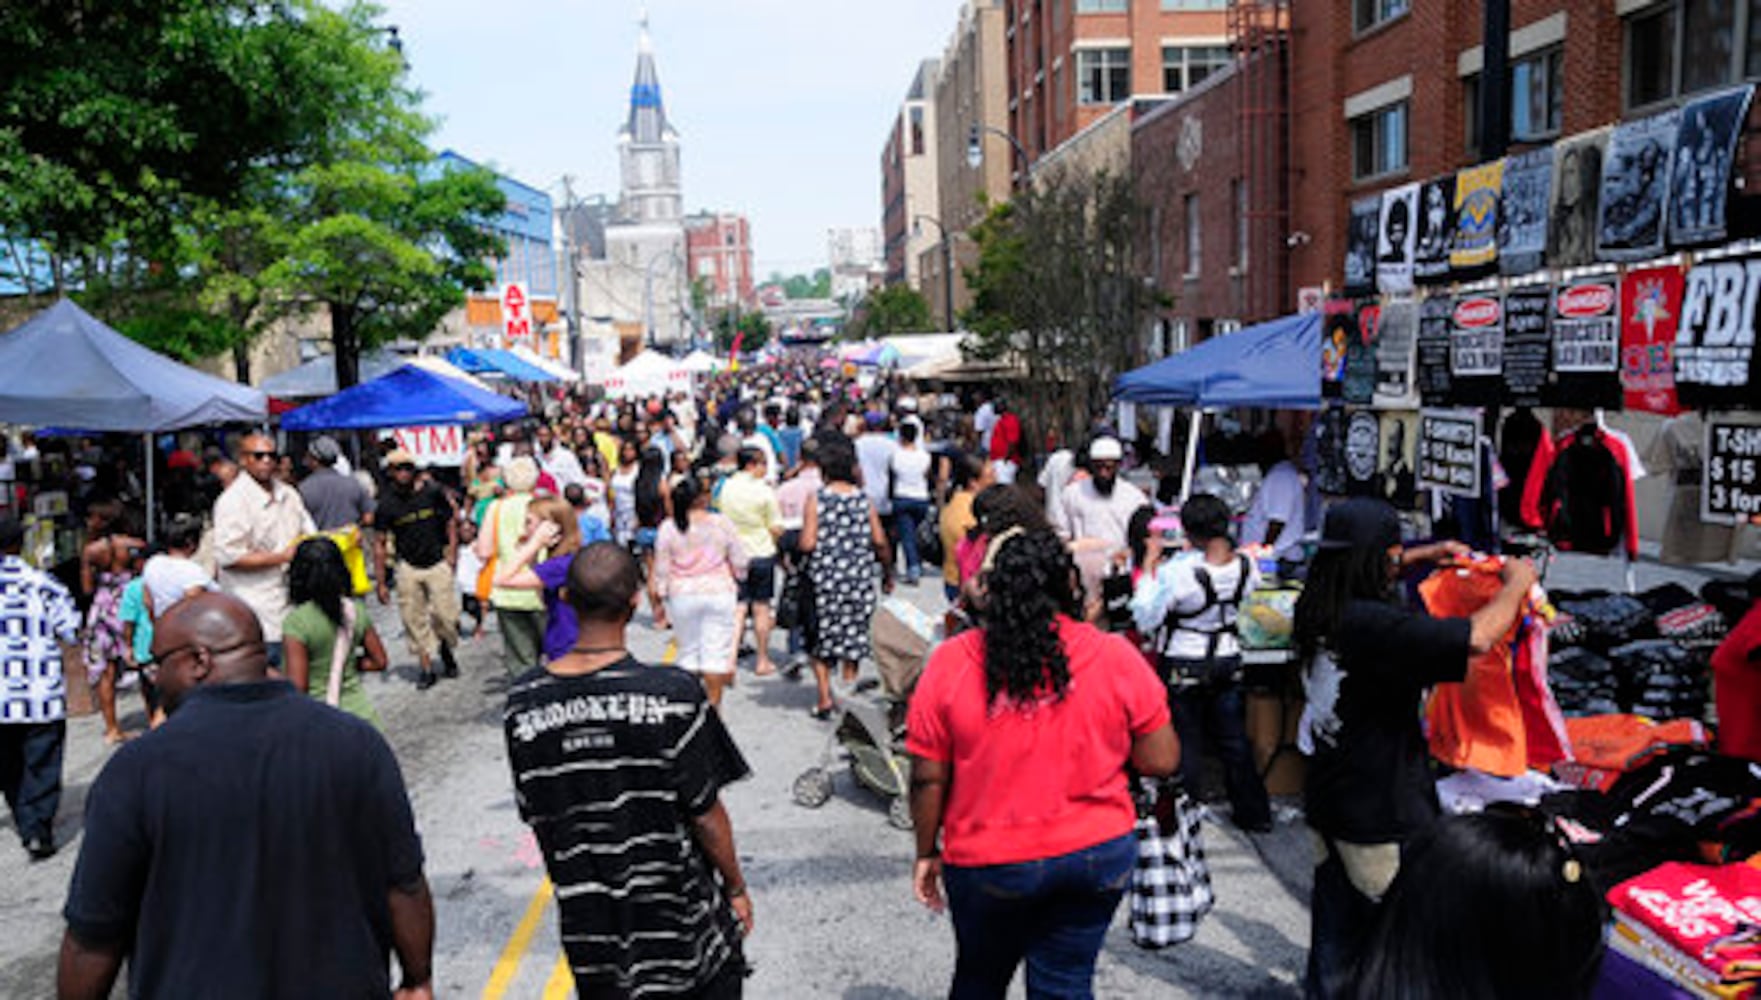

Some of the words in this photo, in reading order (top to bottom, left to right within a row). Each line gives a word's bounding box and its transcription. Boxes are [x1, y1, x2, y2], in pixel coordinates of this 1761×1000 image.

[504, 284, 530, 337] ATM
[1676, 258, 1761, 346] FBI
[1675, 360, 1749, 386] JESUS
[1710, 456, 1724, 481] $
[1728, 459, 1756, 484] 15
[1711, 485, 1726, 509] 3
[1730, 487, 1761, 512] for
[513, 693, 668, 742] BROOKLYN
